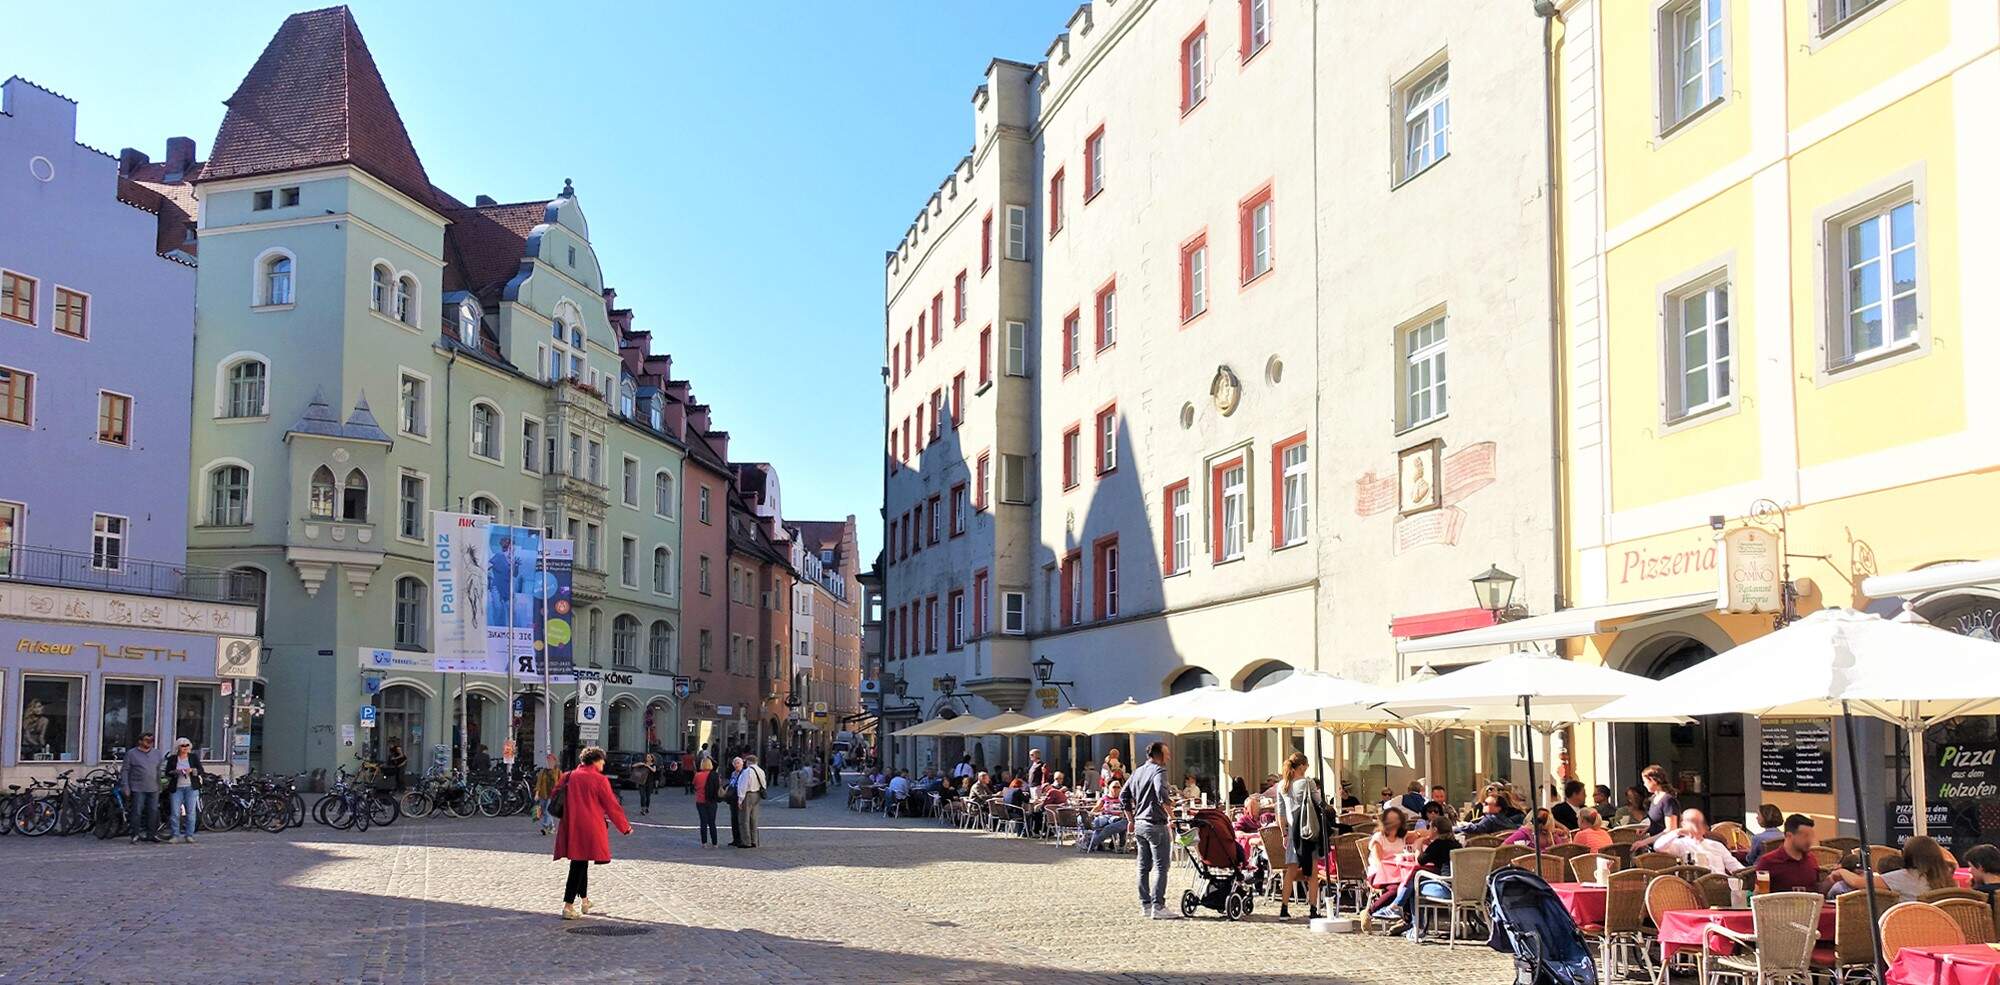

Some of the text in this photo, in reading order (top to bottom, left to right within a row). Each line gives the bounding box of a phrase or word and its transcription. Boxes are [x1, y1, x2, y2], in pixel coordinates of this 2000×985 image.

[436, 534, 451, 571] Holz
[1620, 537, 1716, 584] Pizzeria
[438, 579, 454, 614] Paul
[16, 639, 76, 656] Friseur
[604, 671, 633, 685] KÖNIG
[1940, 745, 1996, 767] Pizza
[1951, 769, 1985, 778] aus dem
[1939, 781, 1997, 799] Holzofen
